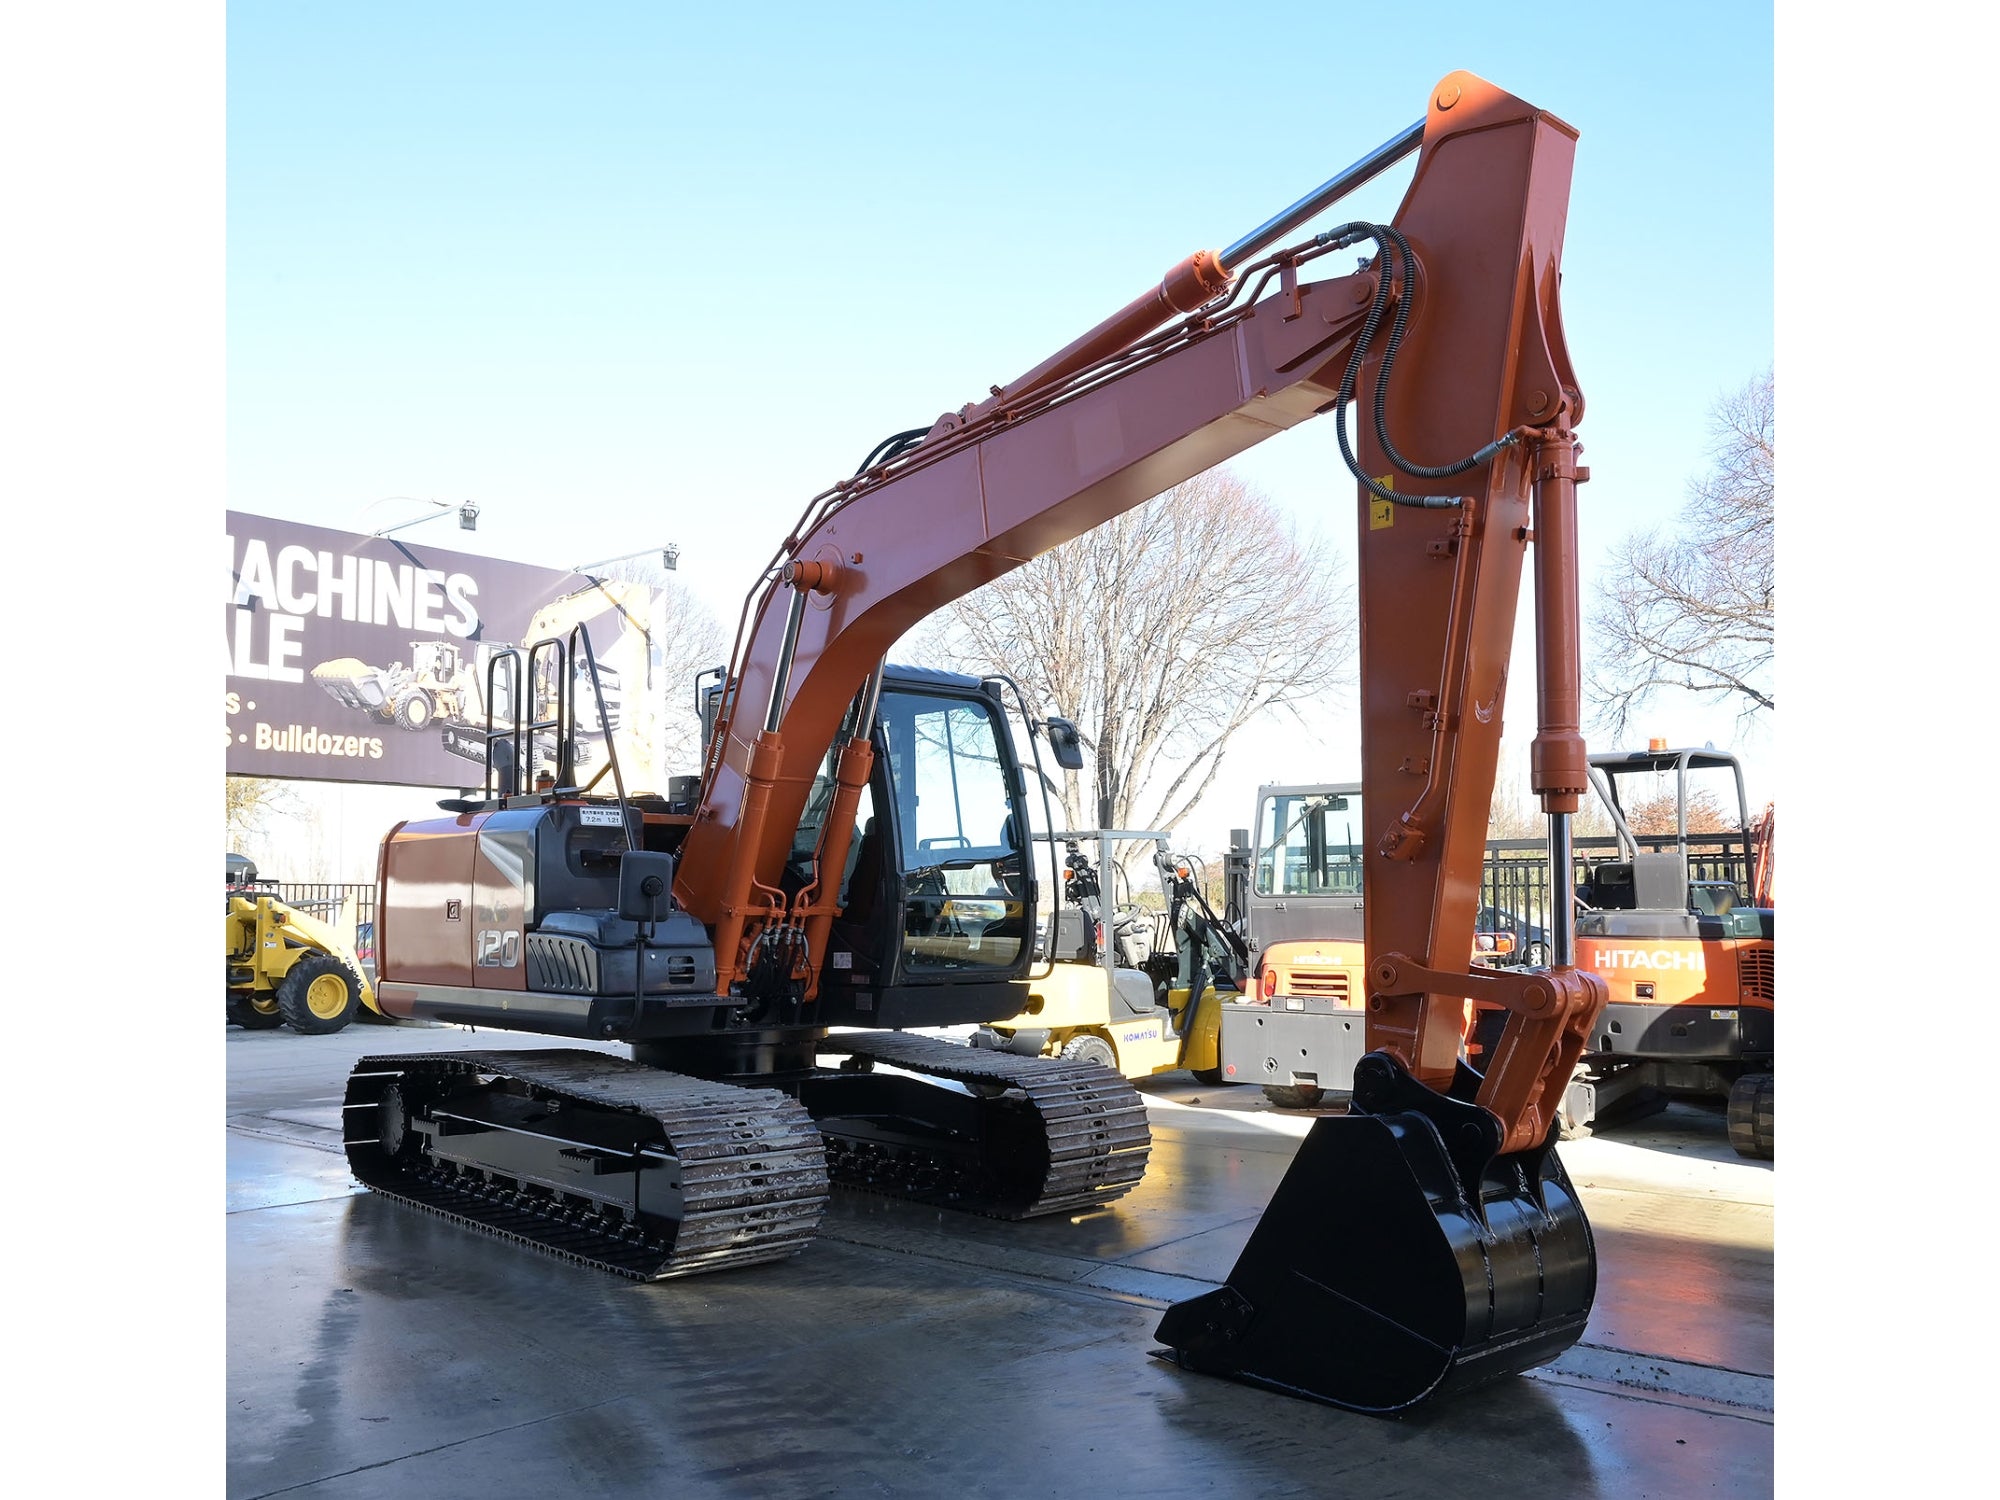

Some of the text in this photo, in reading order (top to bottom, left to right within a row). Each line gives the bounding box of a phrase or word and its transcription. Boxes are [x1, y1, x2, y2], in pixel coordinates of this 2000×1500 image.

[226, 534, 479, 638] ACHINES
[255, 722, 384, 759] Bulldozers
[477, 929, 520, 968] 120
[1593, 949, 1706, 972] HITACHI
[1123, 1029, 1158, 1043] KOMATSU
